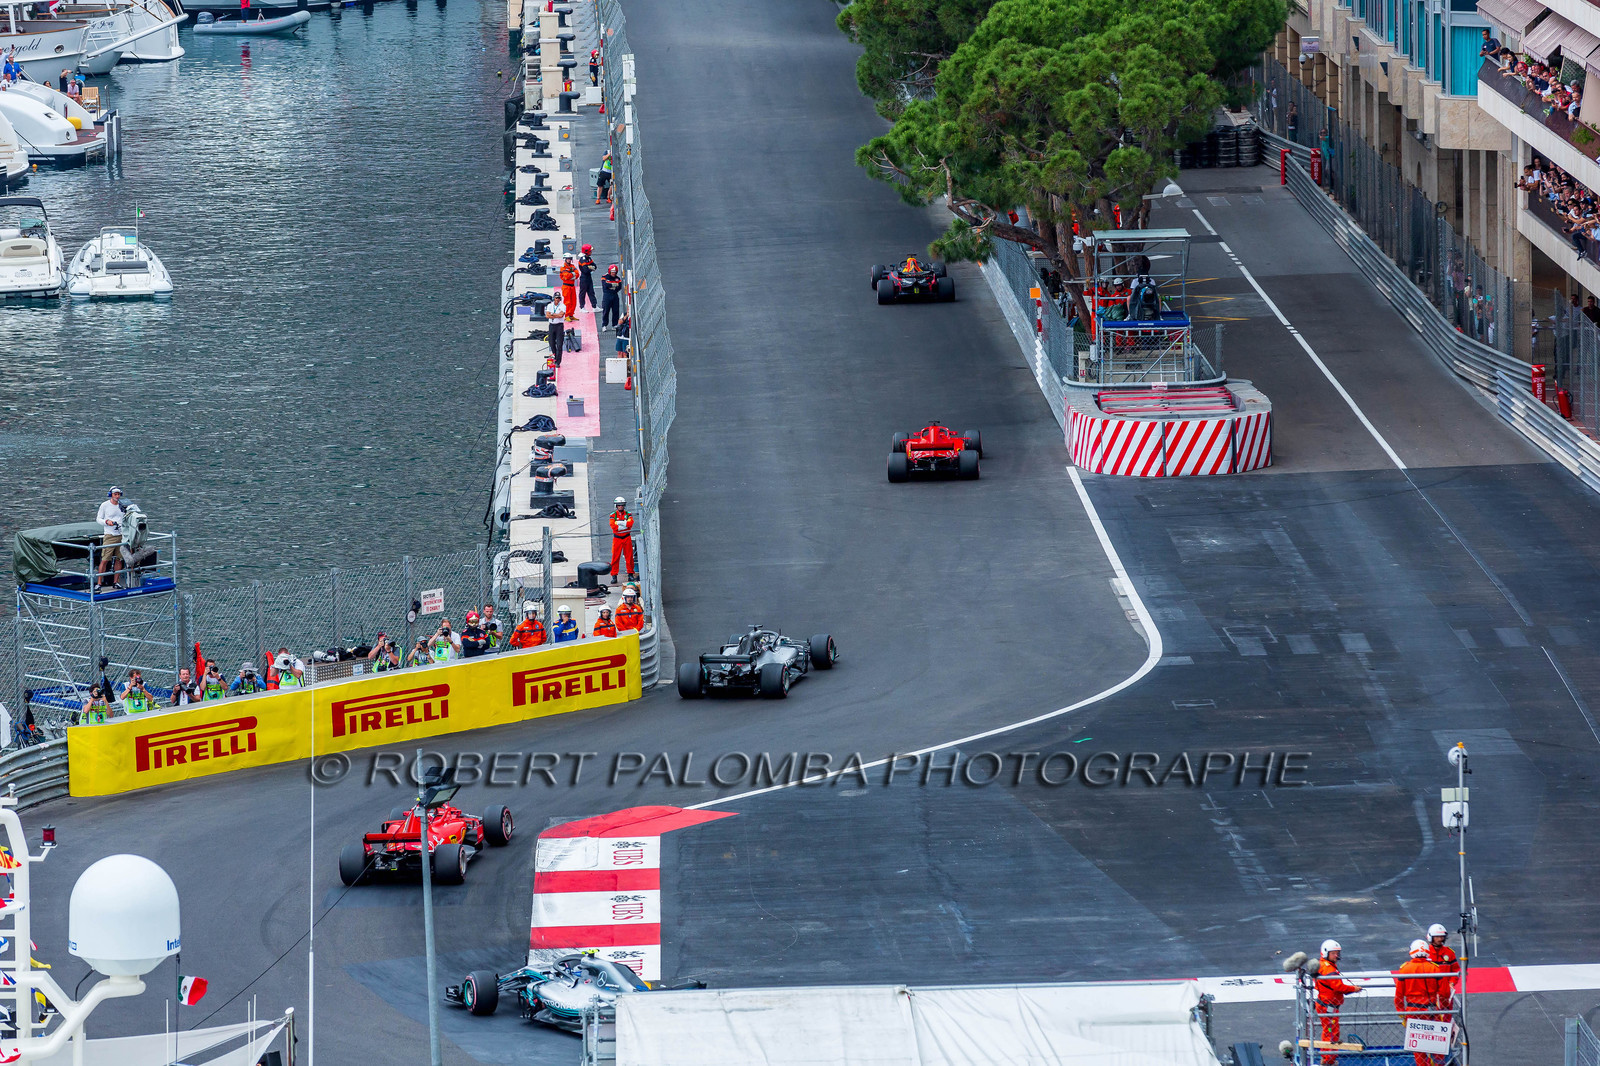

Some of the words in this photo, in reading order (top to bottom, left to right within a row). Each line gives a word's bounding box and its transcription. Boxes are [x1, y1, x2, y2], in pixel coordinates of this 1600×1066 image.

[512, 653, 627, 707] PIRELLI
[331, 683, 450, 738] PIRELLI
[135, 716, 258, 772] PIRELLI
[613, 849, 644, 866] UBS
[612, 902, 644, 920] UBS
[1409, 1022, 1435, 1031] SECTEUR
[1408, 1039, 1418, 1048] 10
[1409, 1032, 1446, 1042] INTERVENTION
